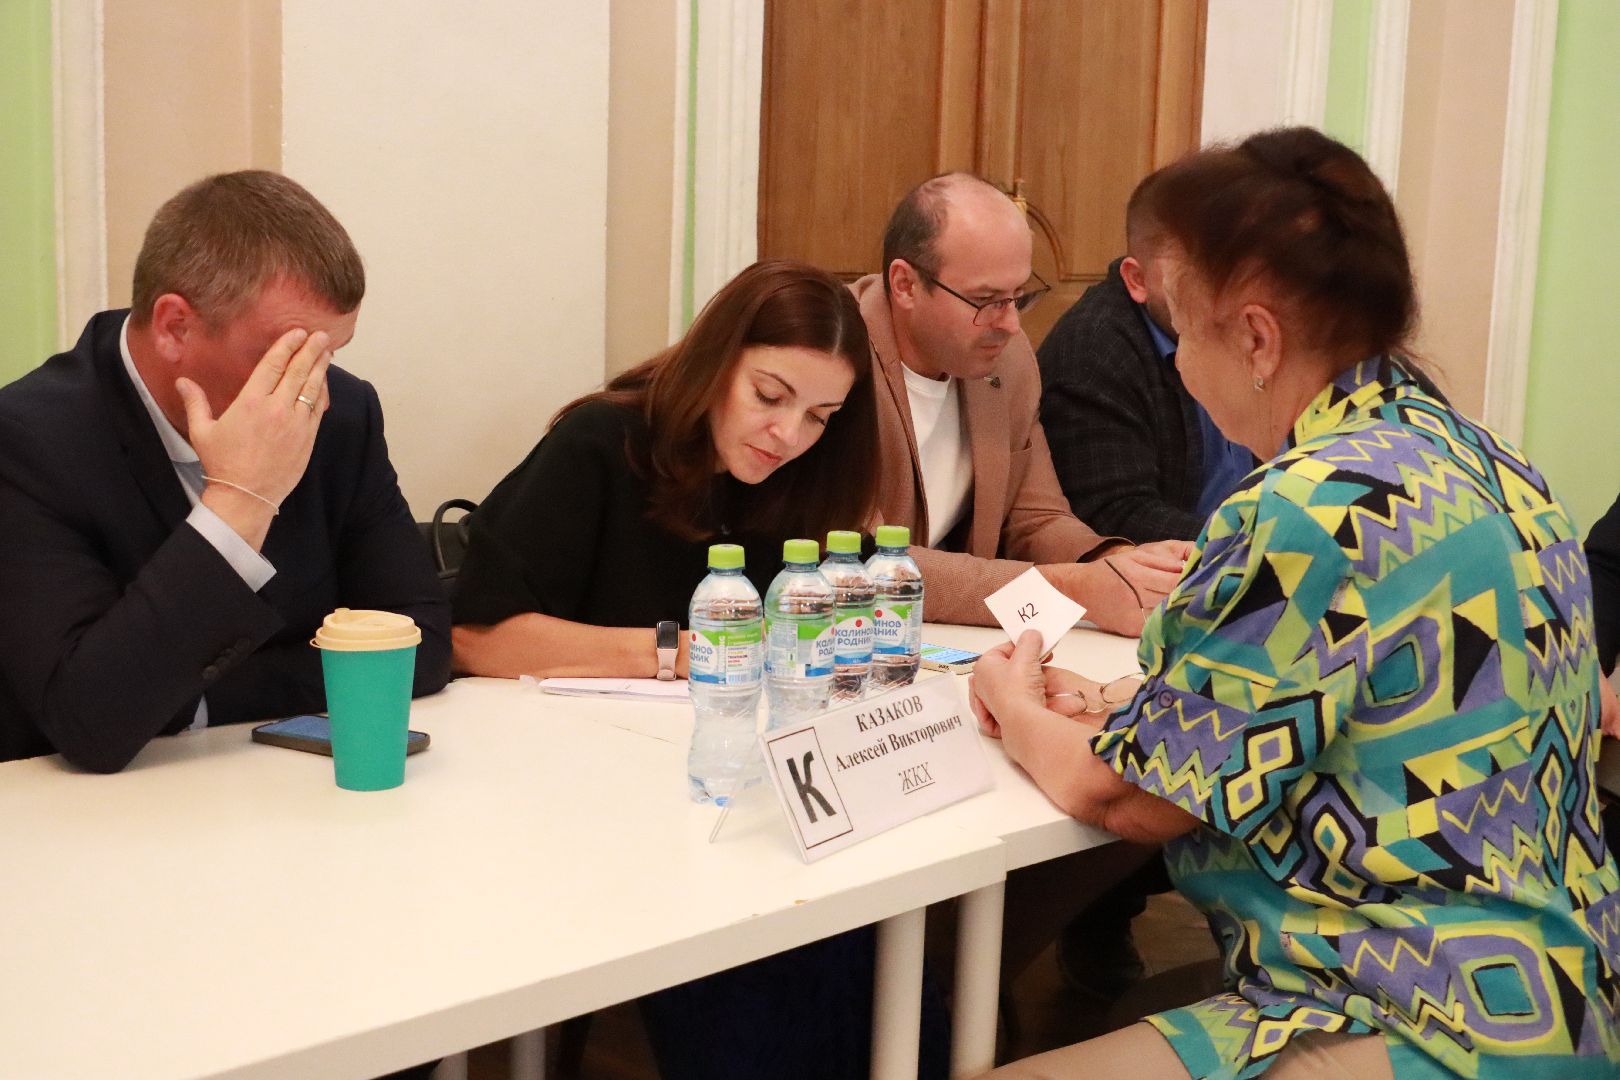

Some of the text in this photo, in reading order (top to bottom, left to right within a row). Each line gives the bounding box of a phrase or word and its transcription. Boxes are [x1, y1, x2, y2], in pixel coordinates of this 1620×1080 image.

[855, 695, 923, 732] КАЗАКОВ
[836, 715, 962, 772] Алексей Викторович
[786, 750, 837, 824] К
[898, 762, 933, 792] ЖКХ
